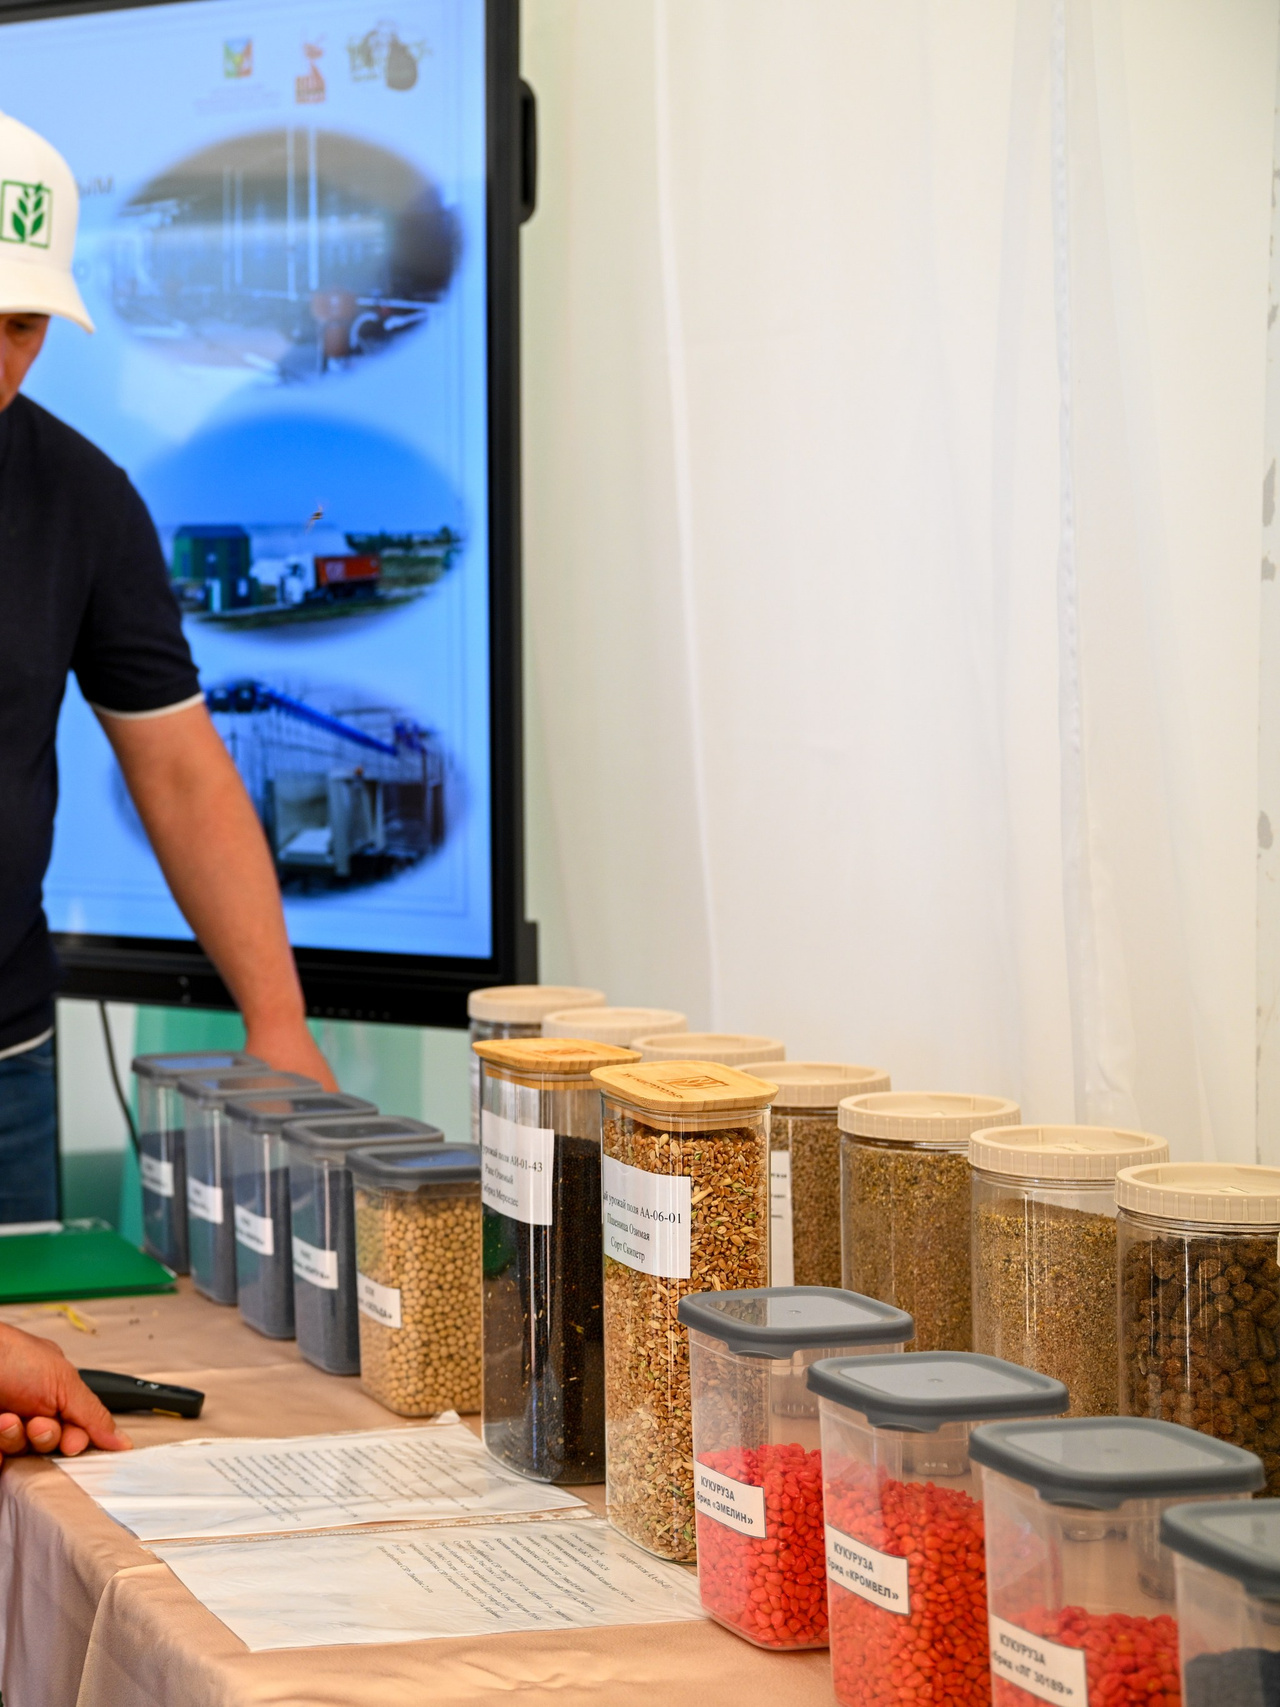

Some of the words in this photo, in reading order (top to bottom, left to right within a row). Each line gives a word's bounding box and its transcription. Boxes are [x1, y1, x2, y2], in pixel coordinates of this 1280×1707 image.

[510, 1155, 543, 1172] АИ-01-43
[609, 1194, 626, 1210] урожай
[626, 1202, 639, 1215] поля
[607, 1212, 629, 1232] Пшеница
[629, 1223, 650, 1241] Озимая
[610, 1236, 623, 1252] Сорт
[622, 1242, 646, 1263] Скипетр
[700, 1475, 735, 1501] КУКУРУЗА
[696, 1490, 712, 1508] брид
[711, 1500, 754, 1525] «ЭМЕЛИН»
[833, 1541, 874, 1572] КУКУРУЗА
[826, 1556, 844, 1576] брид
[845, 1569, 899, 1600] «КРОМВЕЛ»
[999, 1633, 1046, 1665] КУКУРУЗА
